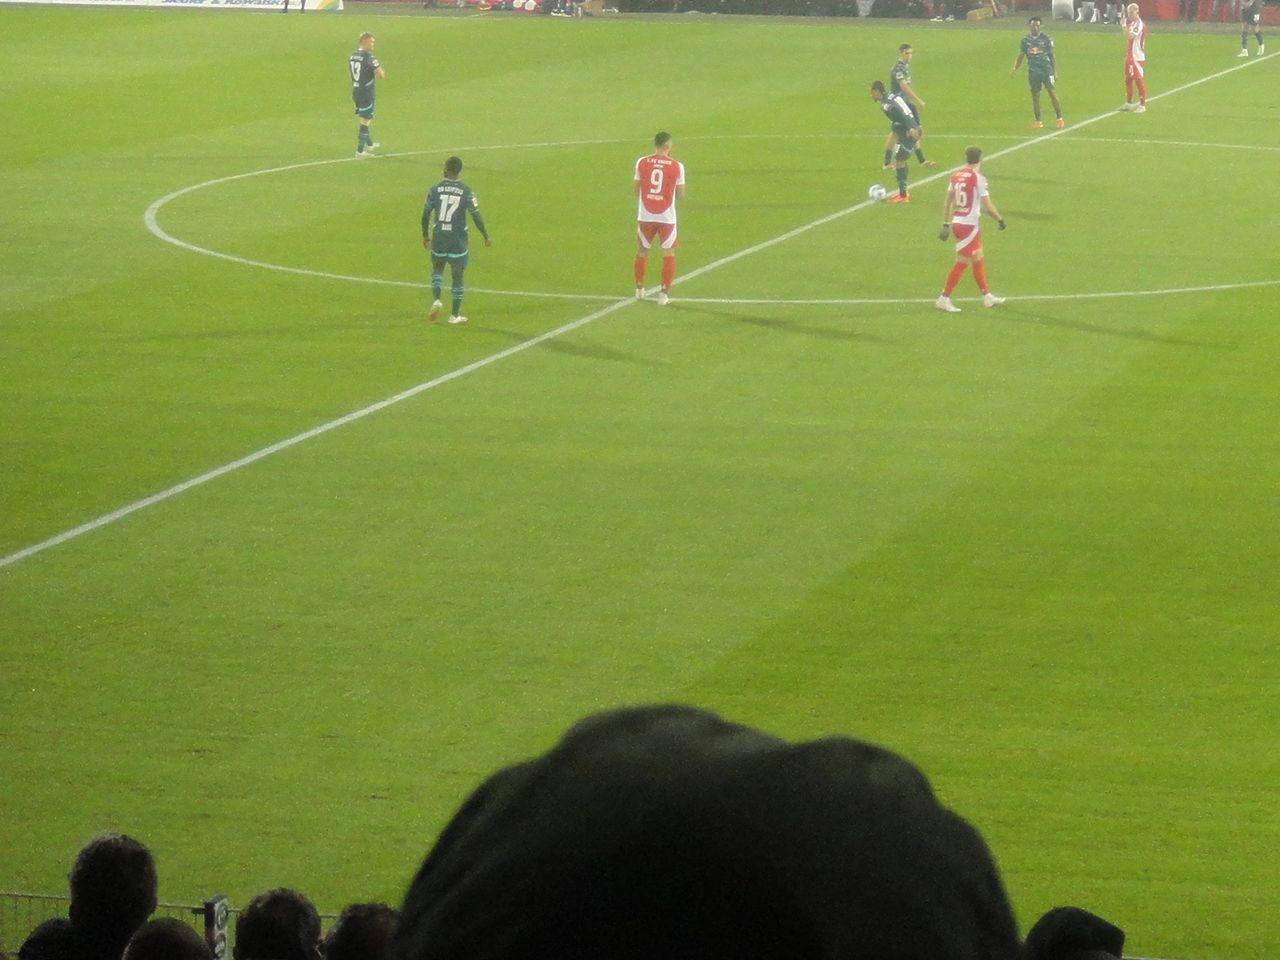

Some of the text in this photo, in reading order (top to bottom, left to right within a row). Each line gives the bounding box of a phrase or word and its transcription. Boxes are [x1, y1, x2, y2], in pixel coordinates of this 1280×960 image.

[350, 61, 361, 82] 13
[651, 169, 663, 193] 9
[439, 194, 461, 222] 17
